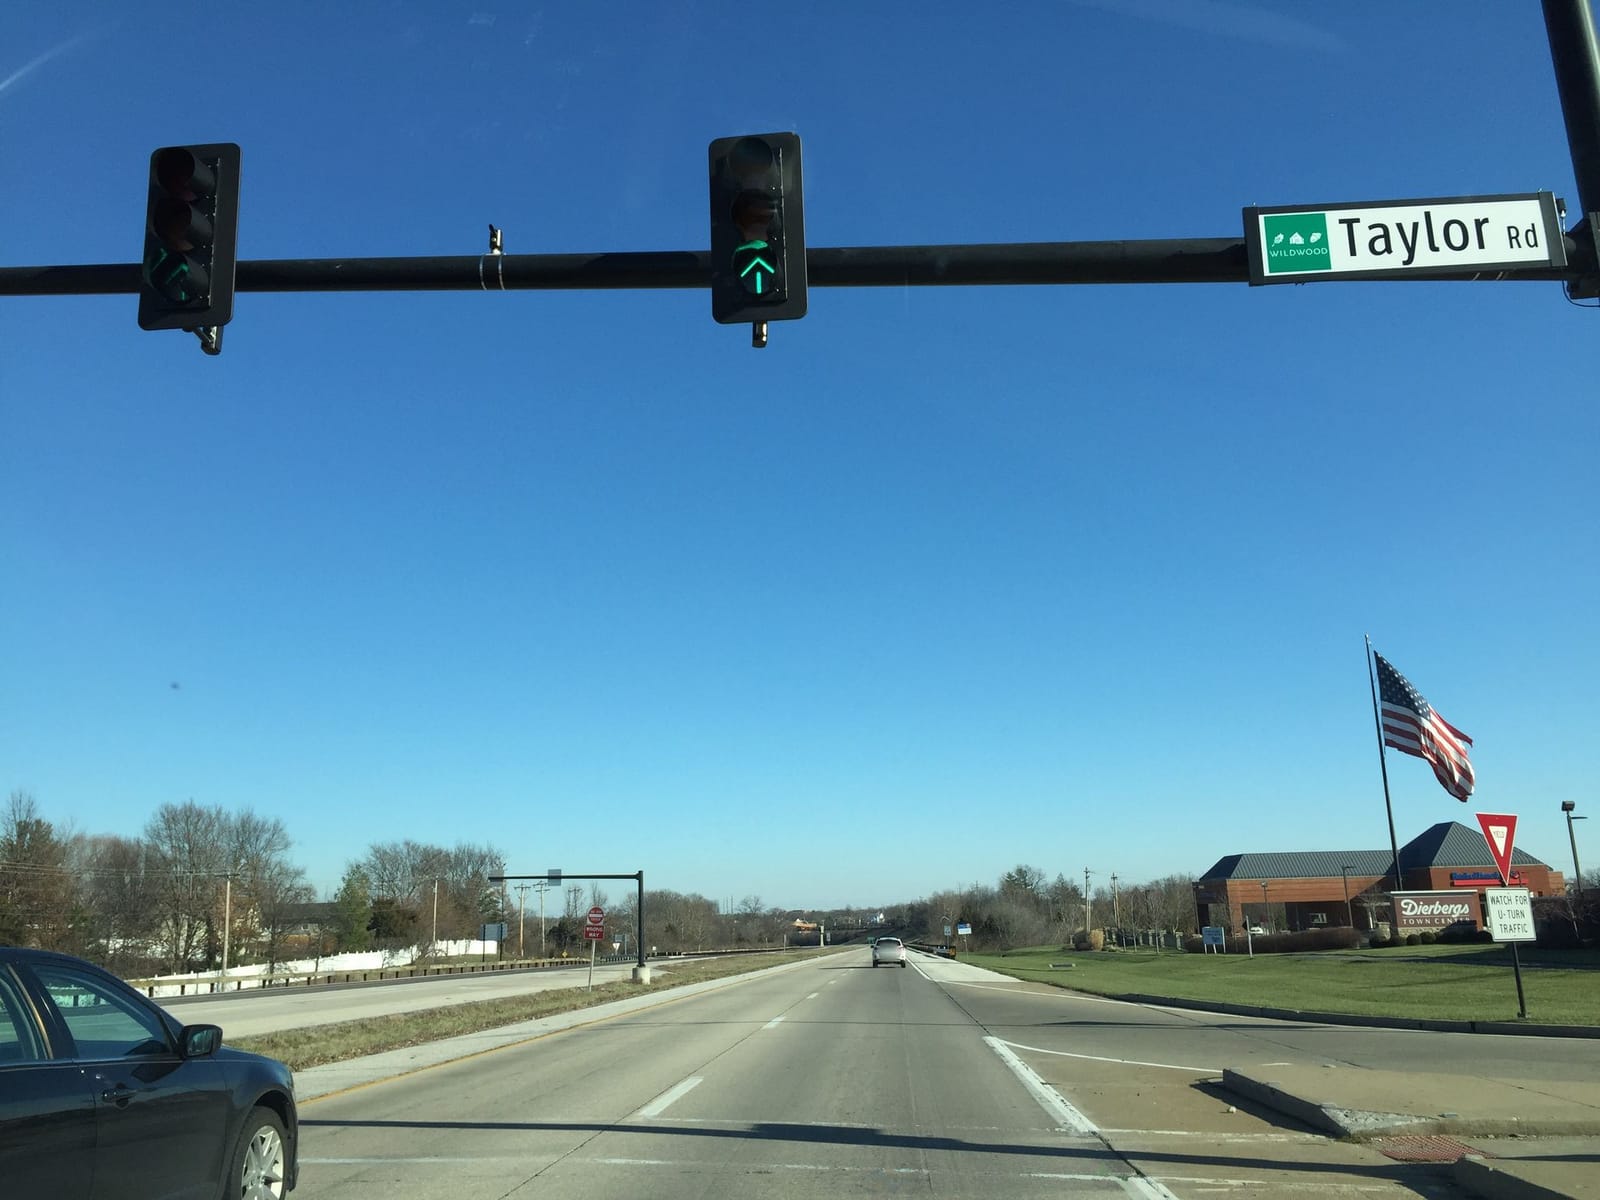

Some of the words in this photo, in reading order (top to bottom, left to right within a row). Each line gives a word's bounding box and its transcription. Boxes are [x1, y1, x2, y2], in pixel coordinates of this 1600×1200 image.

[1338, 211, 1490, 266] Taylor
[1506, 223, 1539, 249] Rd
[1269, 247, 1328, 257] WILDWOOD
[1490, 895, 1512, 905] WATCH
[1515, 895, 1528, 905] FOR
[1400, 899, 1470, 917] Dierbergs
[1499, 924, 1528, 933] TRAFFIC
